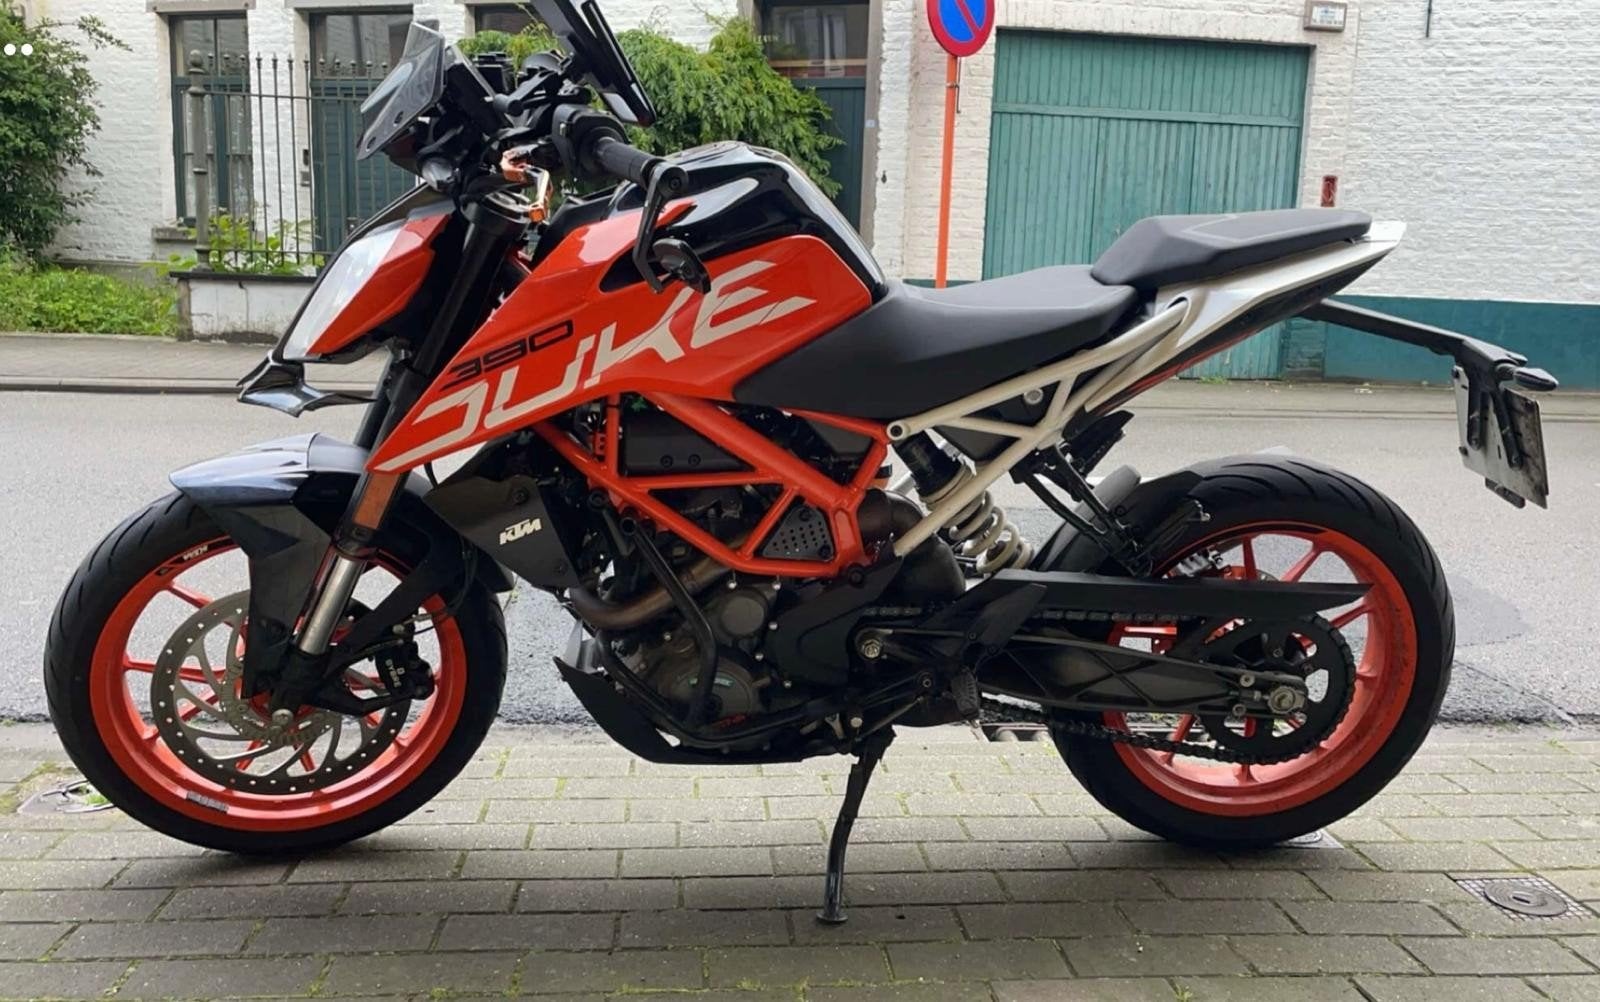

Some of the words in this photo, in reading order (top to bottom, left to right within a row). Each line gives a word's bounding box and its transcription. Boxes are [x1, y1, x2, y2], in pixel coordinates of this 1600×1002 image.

[379, 259, 818, 472] DUKE
[438, 319, 575, 394] 390
[499, 518, 542, 545] KTM
